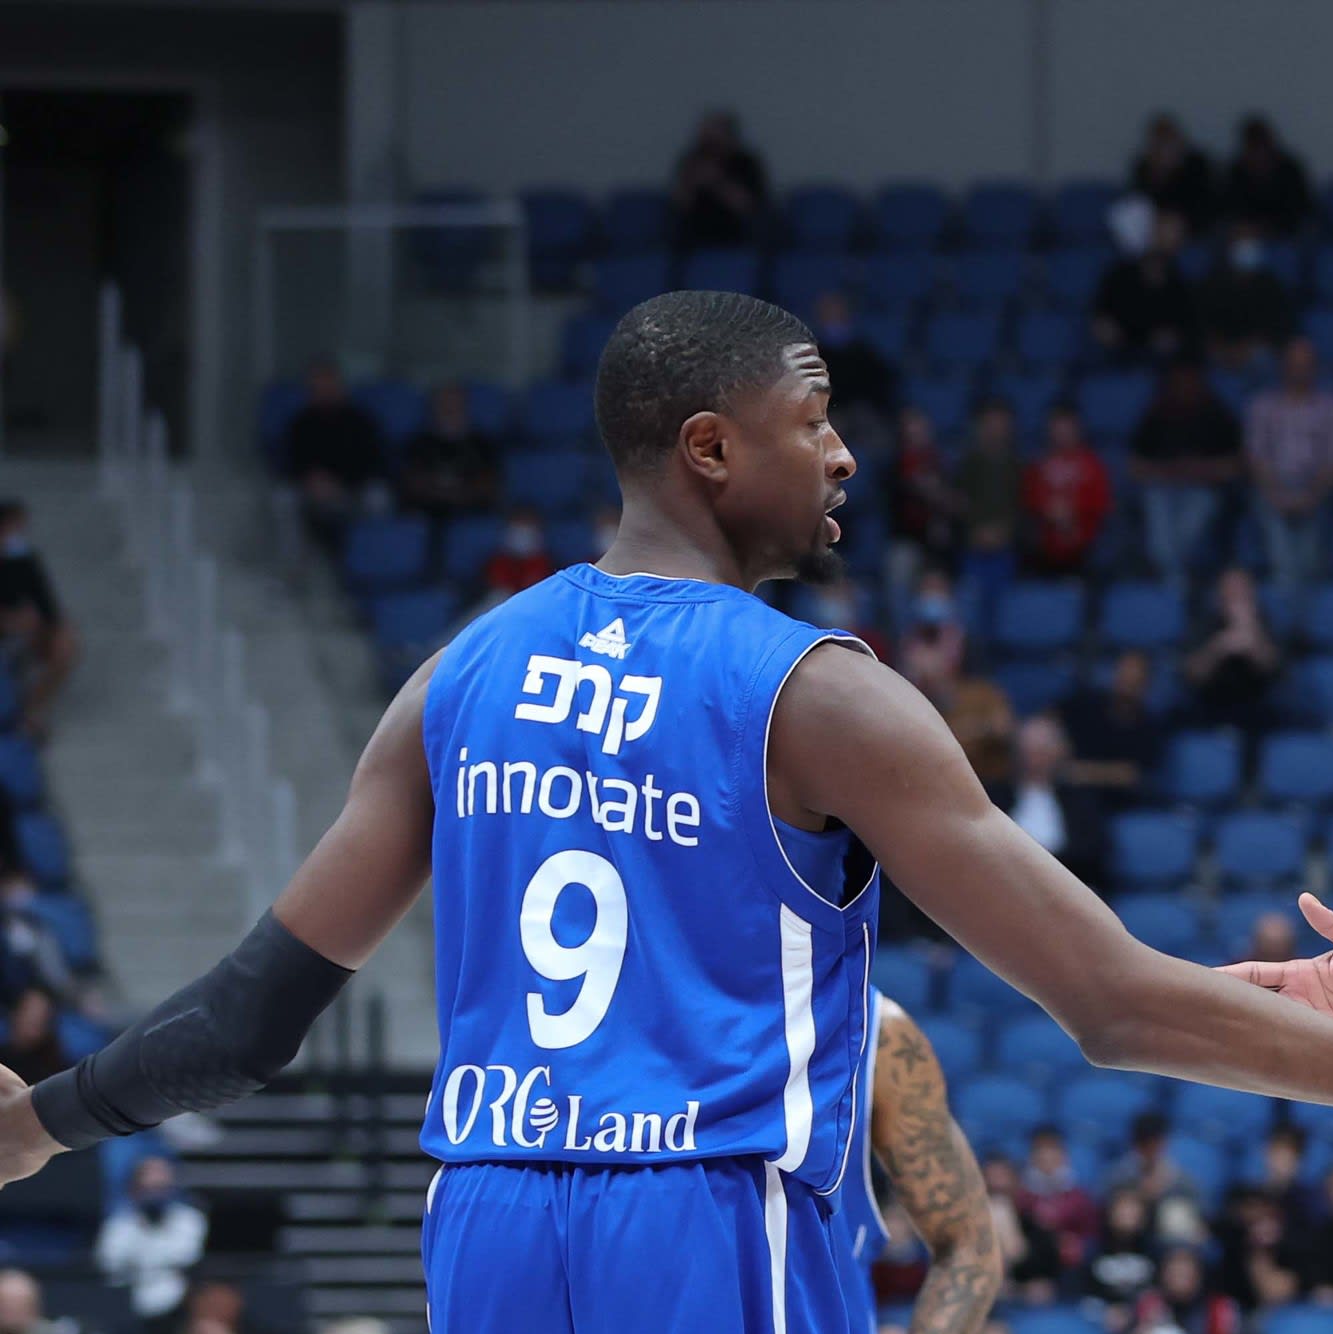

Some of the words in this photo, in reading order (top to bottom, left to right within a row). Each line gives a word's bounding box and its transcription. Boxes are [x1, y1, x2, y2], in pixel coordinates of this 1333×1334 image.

[456, 747, 701, 847] innovate
[519, 849, 629, 1051] 9
[563, 1100, 700, 1154] Land
